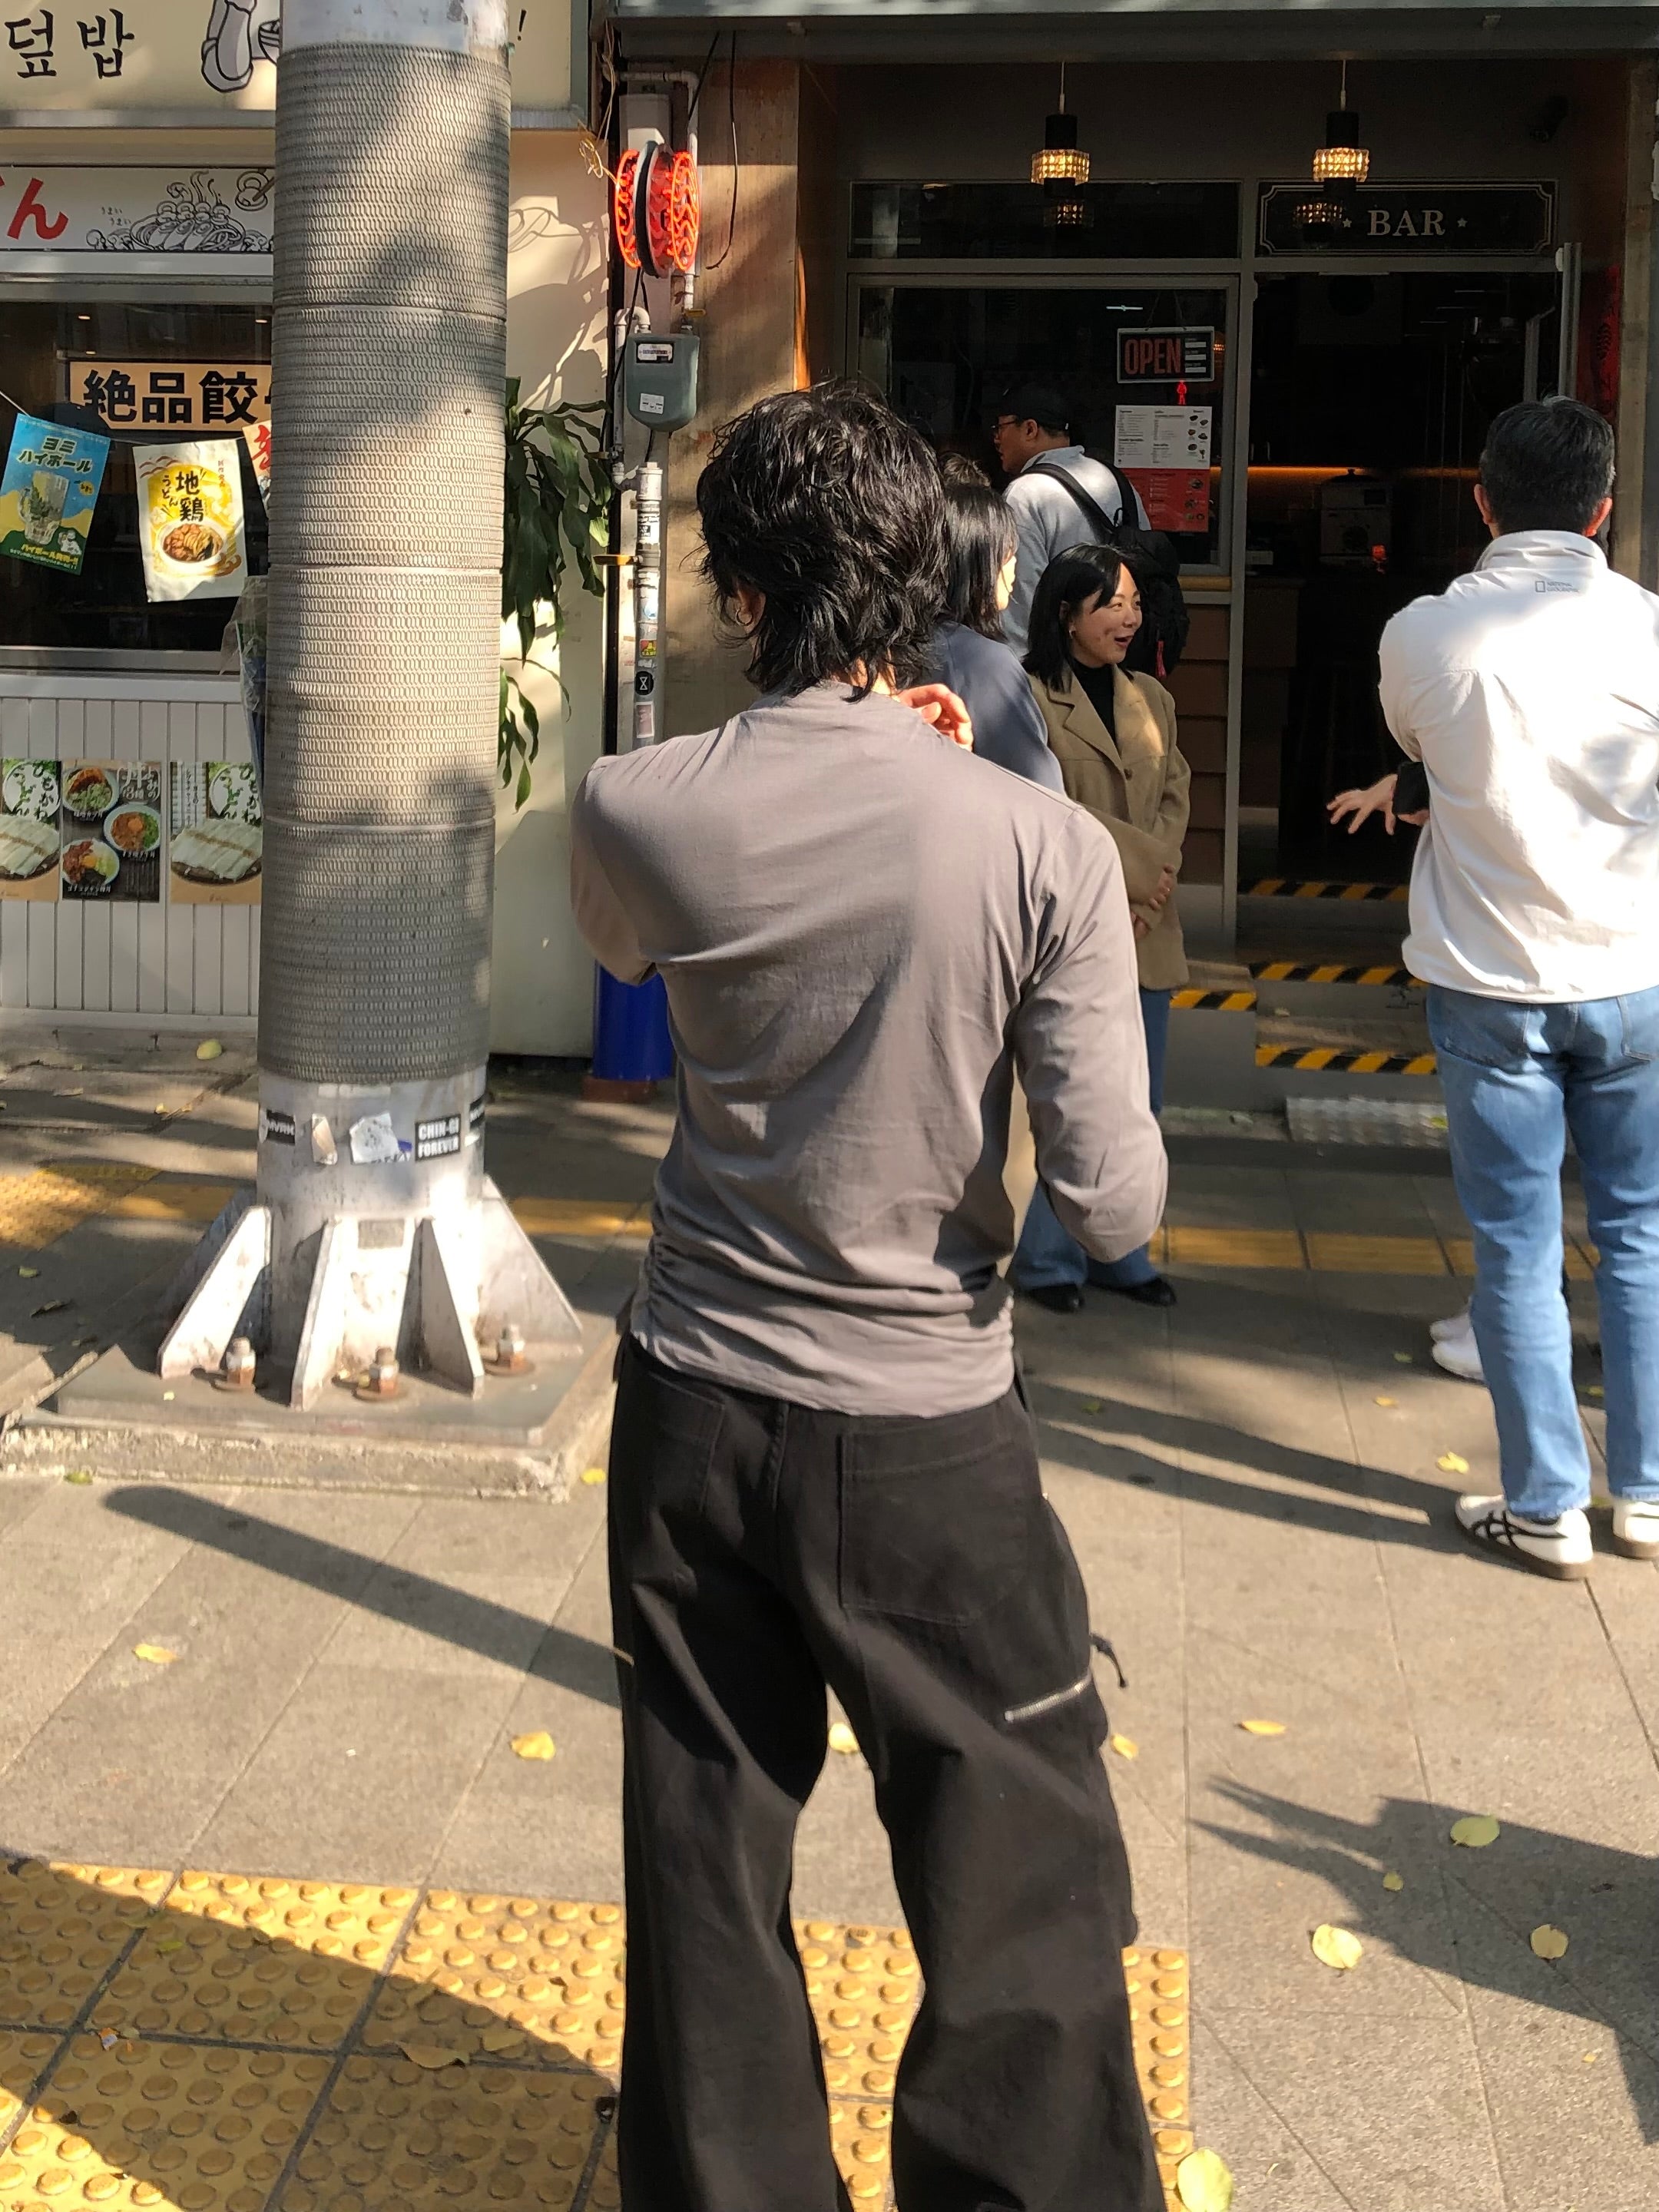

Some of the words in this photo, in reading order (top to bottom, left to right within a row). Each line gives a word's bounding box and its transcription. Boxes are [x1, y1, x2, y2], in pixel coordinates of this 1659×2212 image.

[5, 8, 135, 79] 덮밥
[0, 175, 69, 240] ん
[1367, 210, 1445, 237] BAR
[1124, 338, 1181, 375] OPEN
[82, 369, 272, 424] 絶品餃
[161, 475, 178, 507] うどん
[419, 1117, 459, 1141] CHIN-GI
